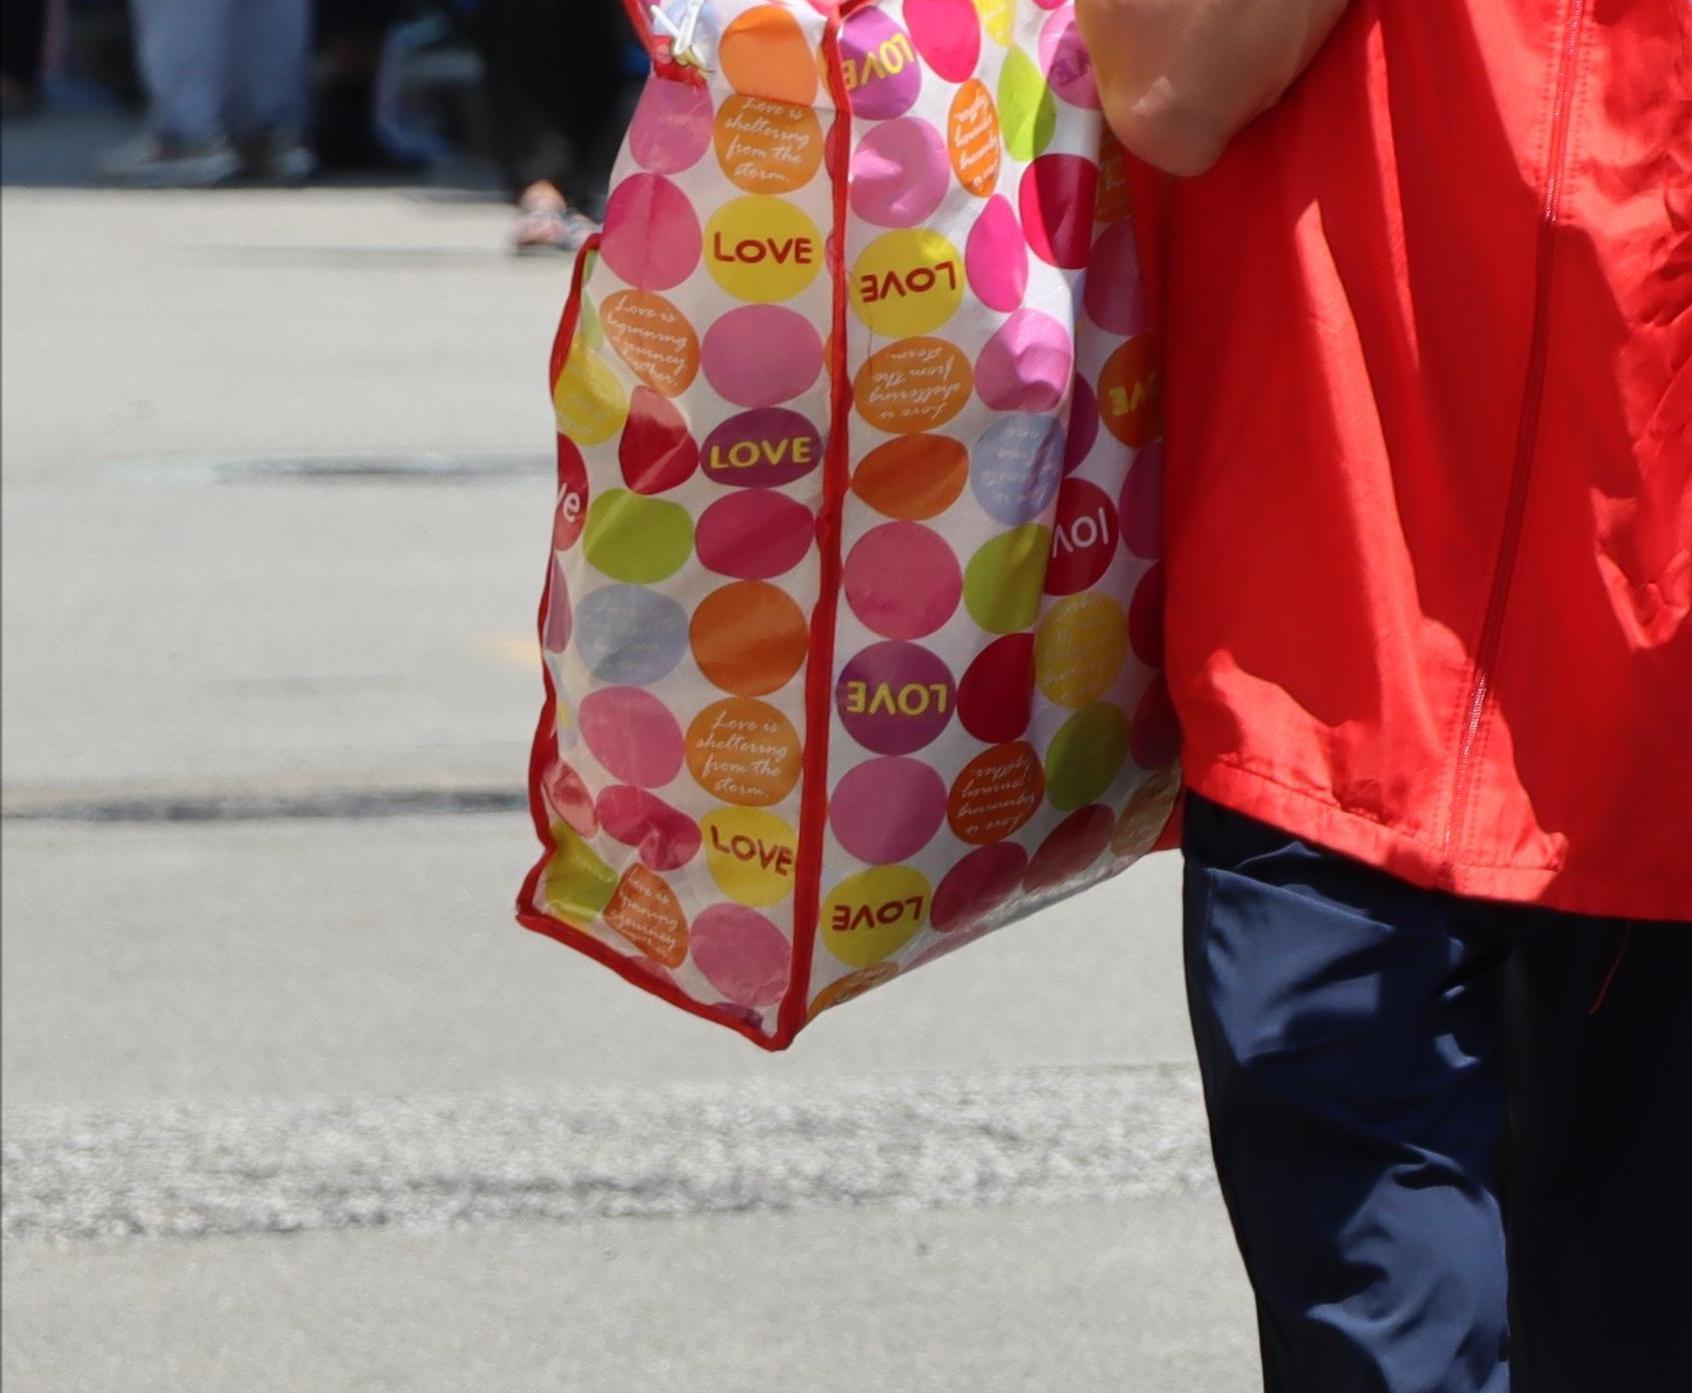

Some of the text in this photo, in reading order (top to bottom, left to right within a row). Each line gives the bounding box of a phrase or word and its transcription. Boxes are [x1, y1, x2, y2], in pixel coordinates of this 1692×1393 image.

[841, 32, 915, 90] LOVE
[713, 231, 813, 265] LOVE
[860, 260, 956, 303] LOVE
[710, 436, 812, 469] LOVE
[846, 680, 948, 716] LOVE
[712, 710, 757, 730] Love
[696, 731, 788, 762] sheltering
[702, 753, 746, 778] from
[710, 824, 793, 877] LOVE
[832, 895, 925, 932] LOVE
